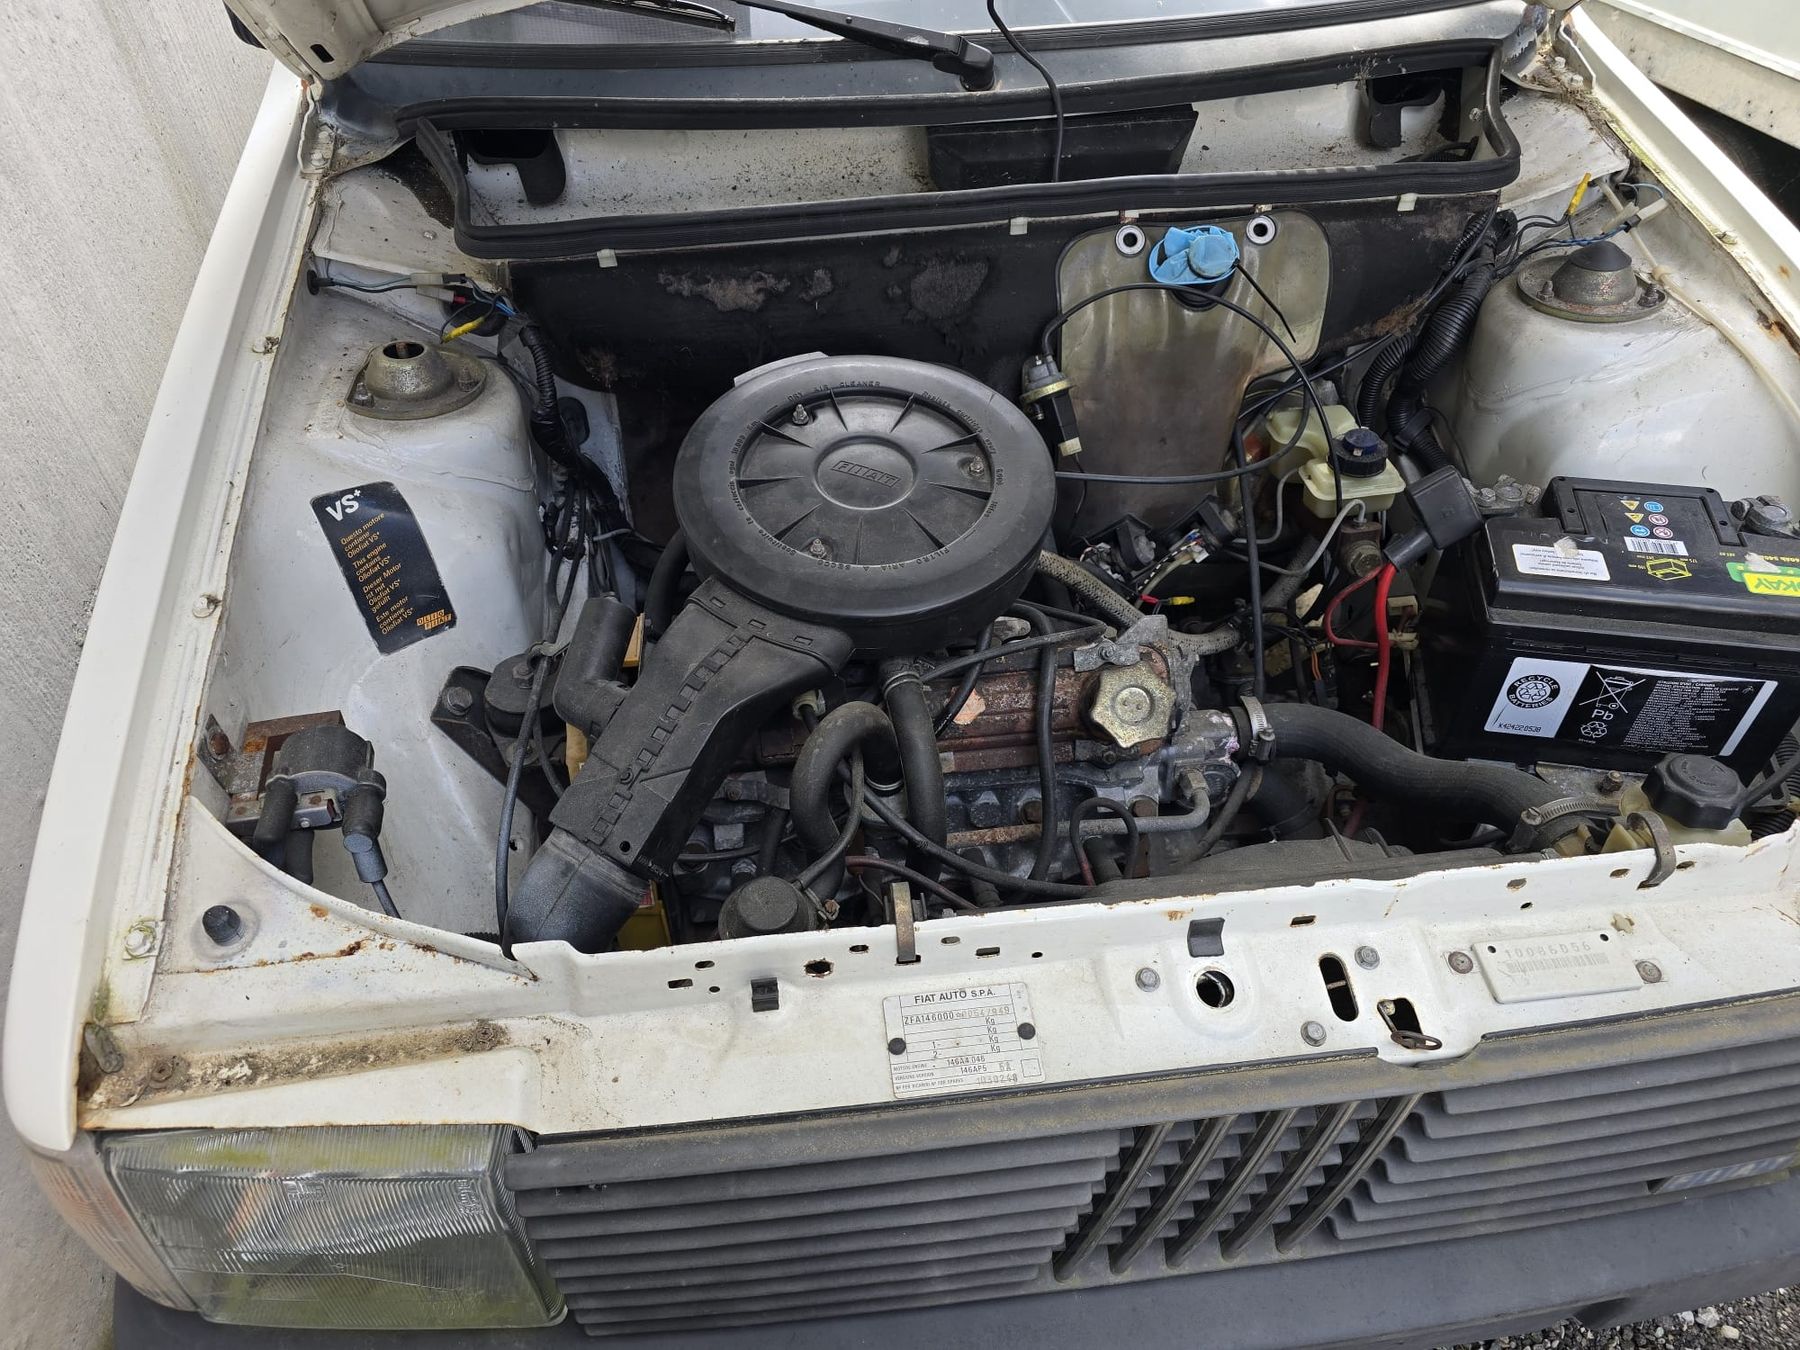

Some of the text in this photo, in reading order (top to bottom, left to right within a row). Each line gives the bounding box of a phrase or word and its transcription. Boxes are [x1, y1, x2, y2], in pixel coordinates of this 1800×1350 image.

[832, 460, 901, 488] FIAT
[340, 512, 385, 545] Questo motore
[345, 531, 370, 552] contiene
[352, 542, 387, 569] This engine
[915, 546, 951, 565] FILTRO
[356, 556, 382, 576] contains
[880, 562, 906, 571] ARIA
[362, 562, 402, 593] Dieser Motor
[375, 596, 409, 623] Este motor
[379, 607, 405, 629] contiene
[1514, 675, 1559, 690] RECYCLE
[1509, 693, 1554, 709] BATTERIES
[1591, 708, 1614, 721] Pb
[914, 989, 996, 1005] FIAT AUTO S.P.A.
[985, 1017, 996, 1025] Kg
[986, 1026, 998, 1034] Kg
[988, 1035, 999, 1043] Kg
[990, 1044, 1001, 1052] Kg
